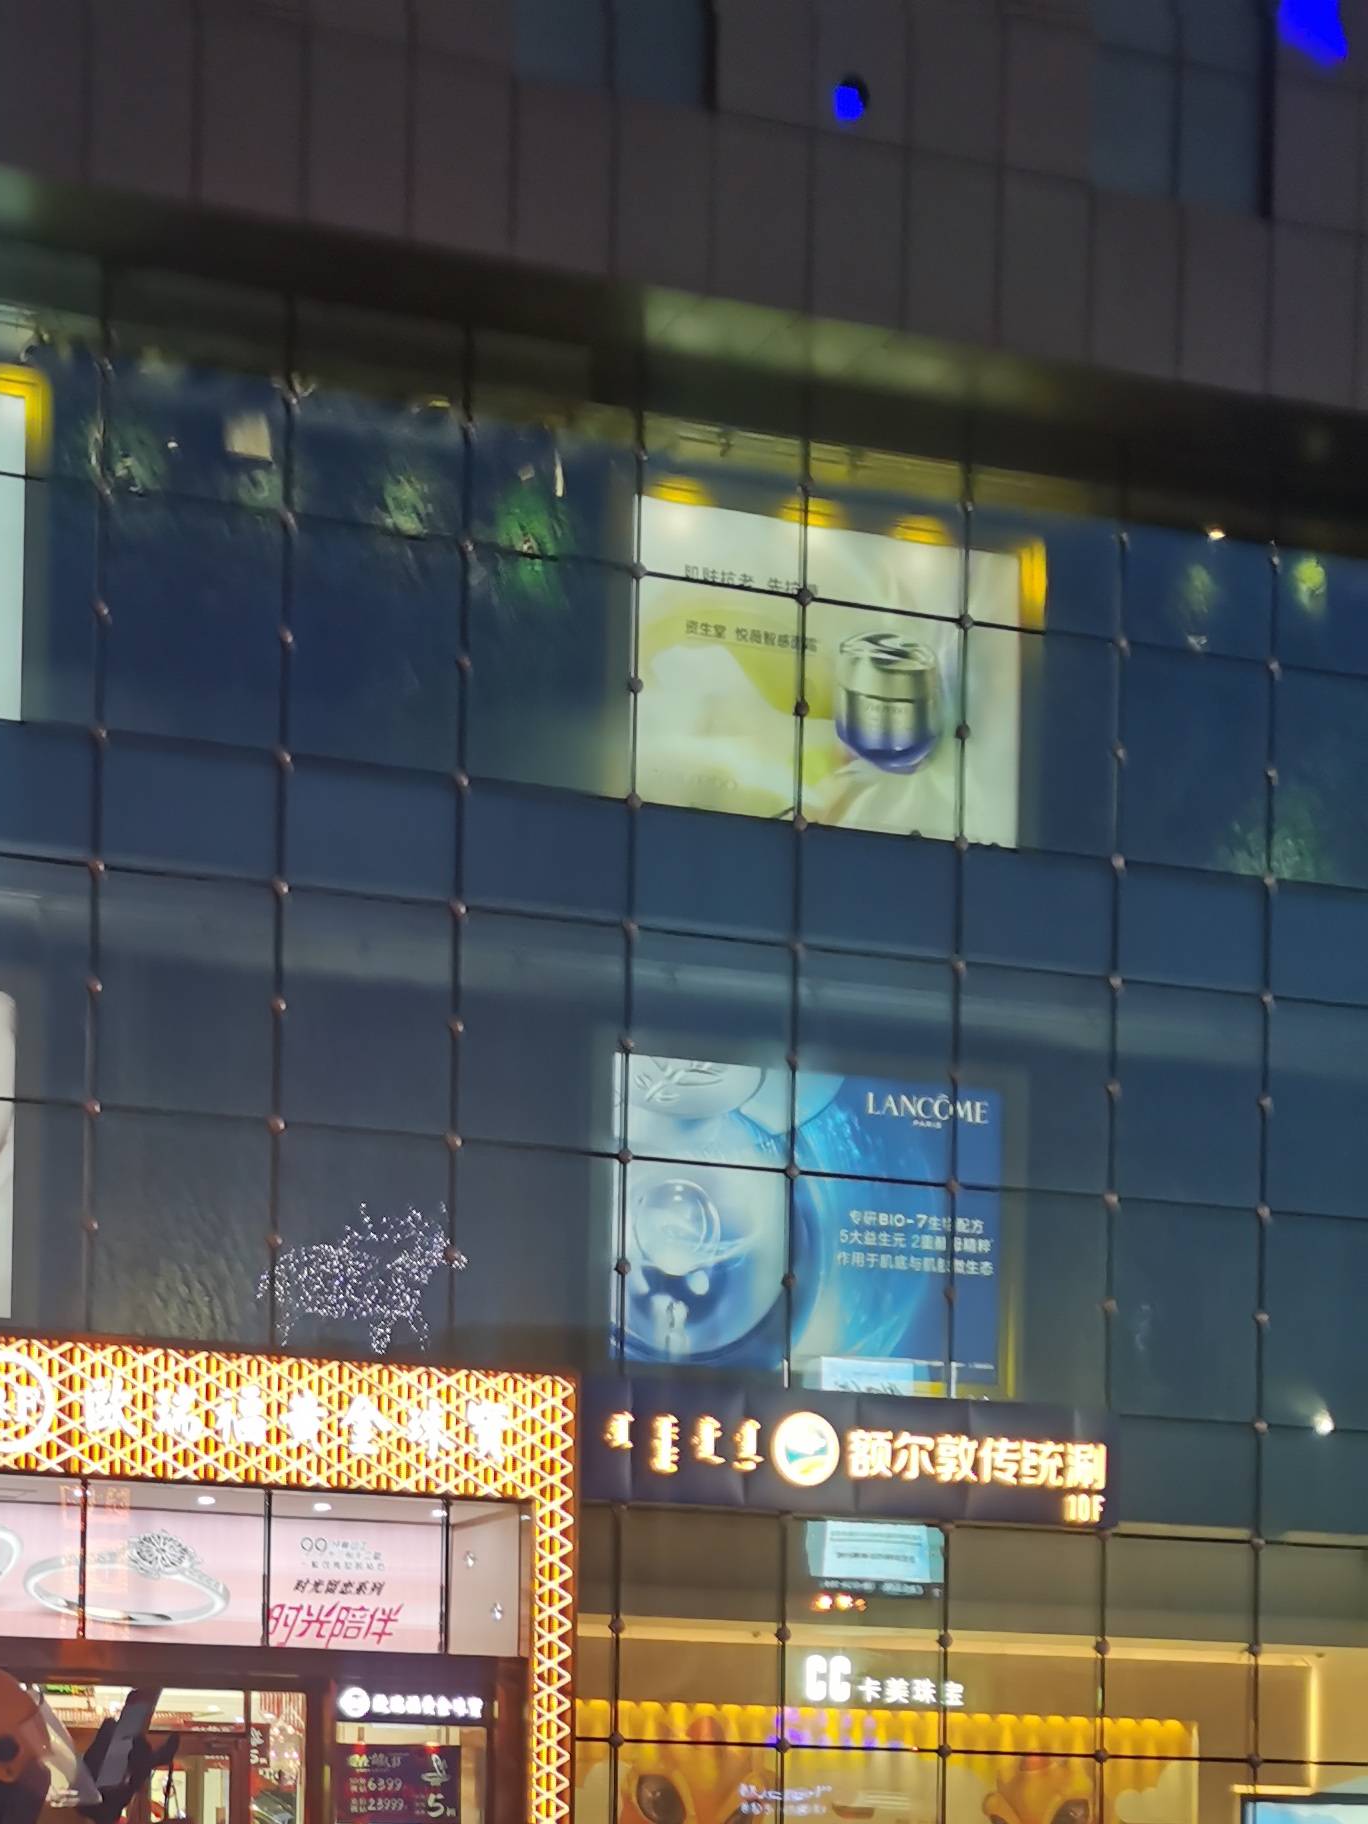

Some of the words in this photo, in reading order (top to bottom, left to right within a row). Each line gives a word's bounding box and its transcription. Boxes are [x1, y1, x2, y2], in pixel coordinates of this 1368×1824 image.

[846, 1428, 1108, 1491] 额尔敦传统涮
